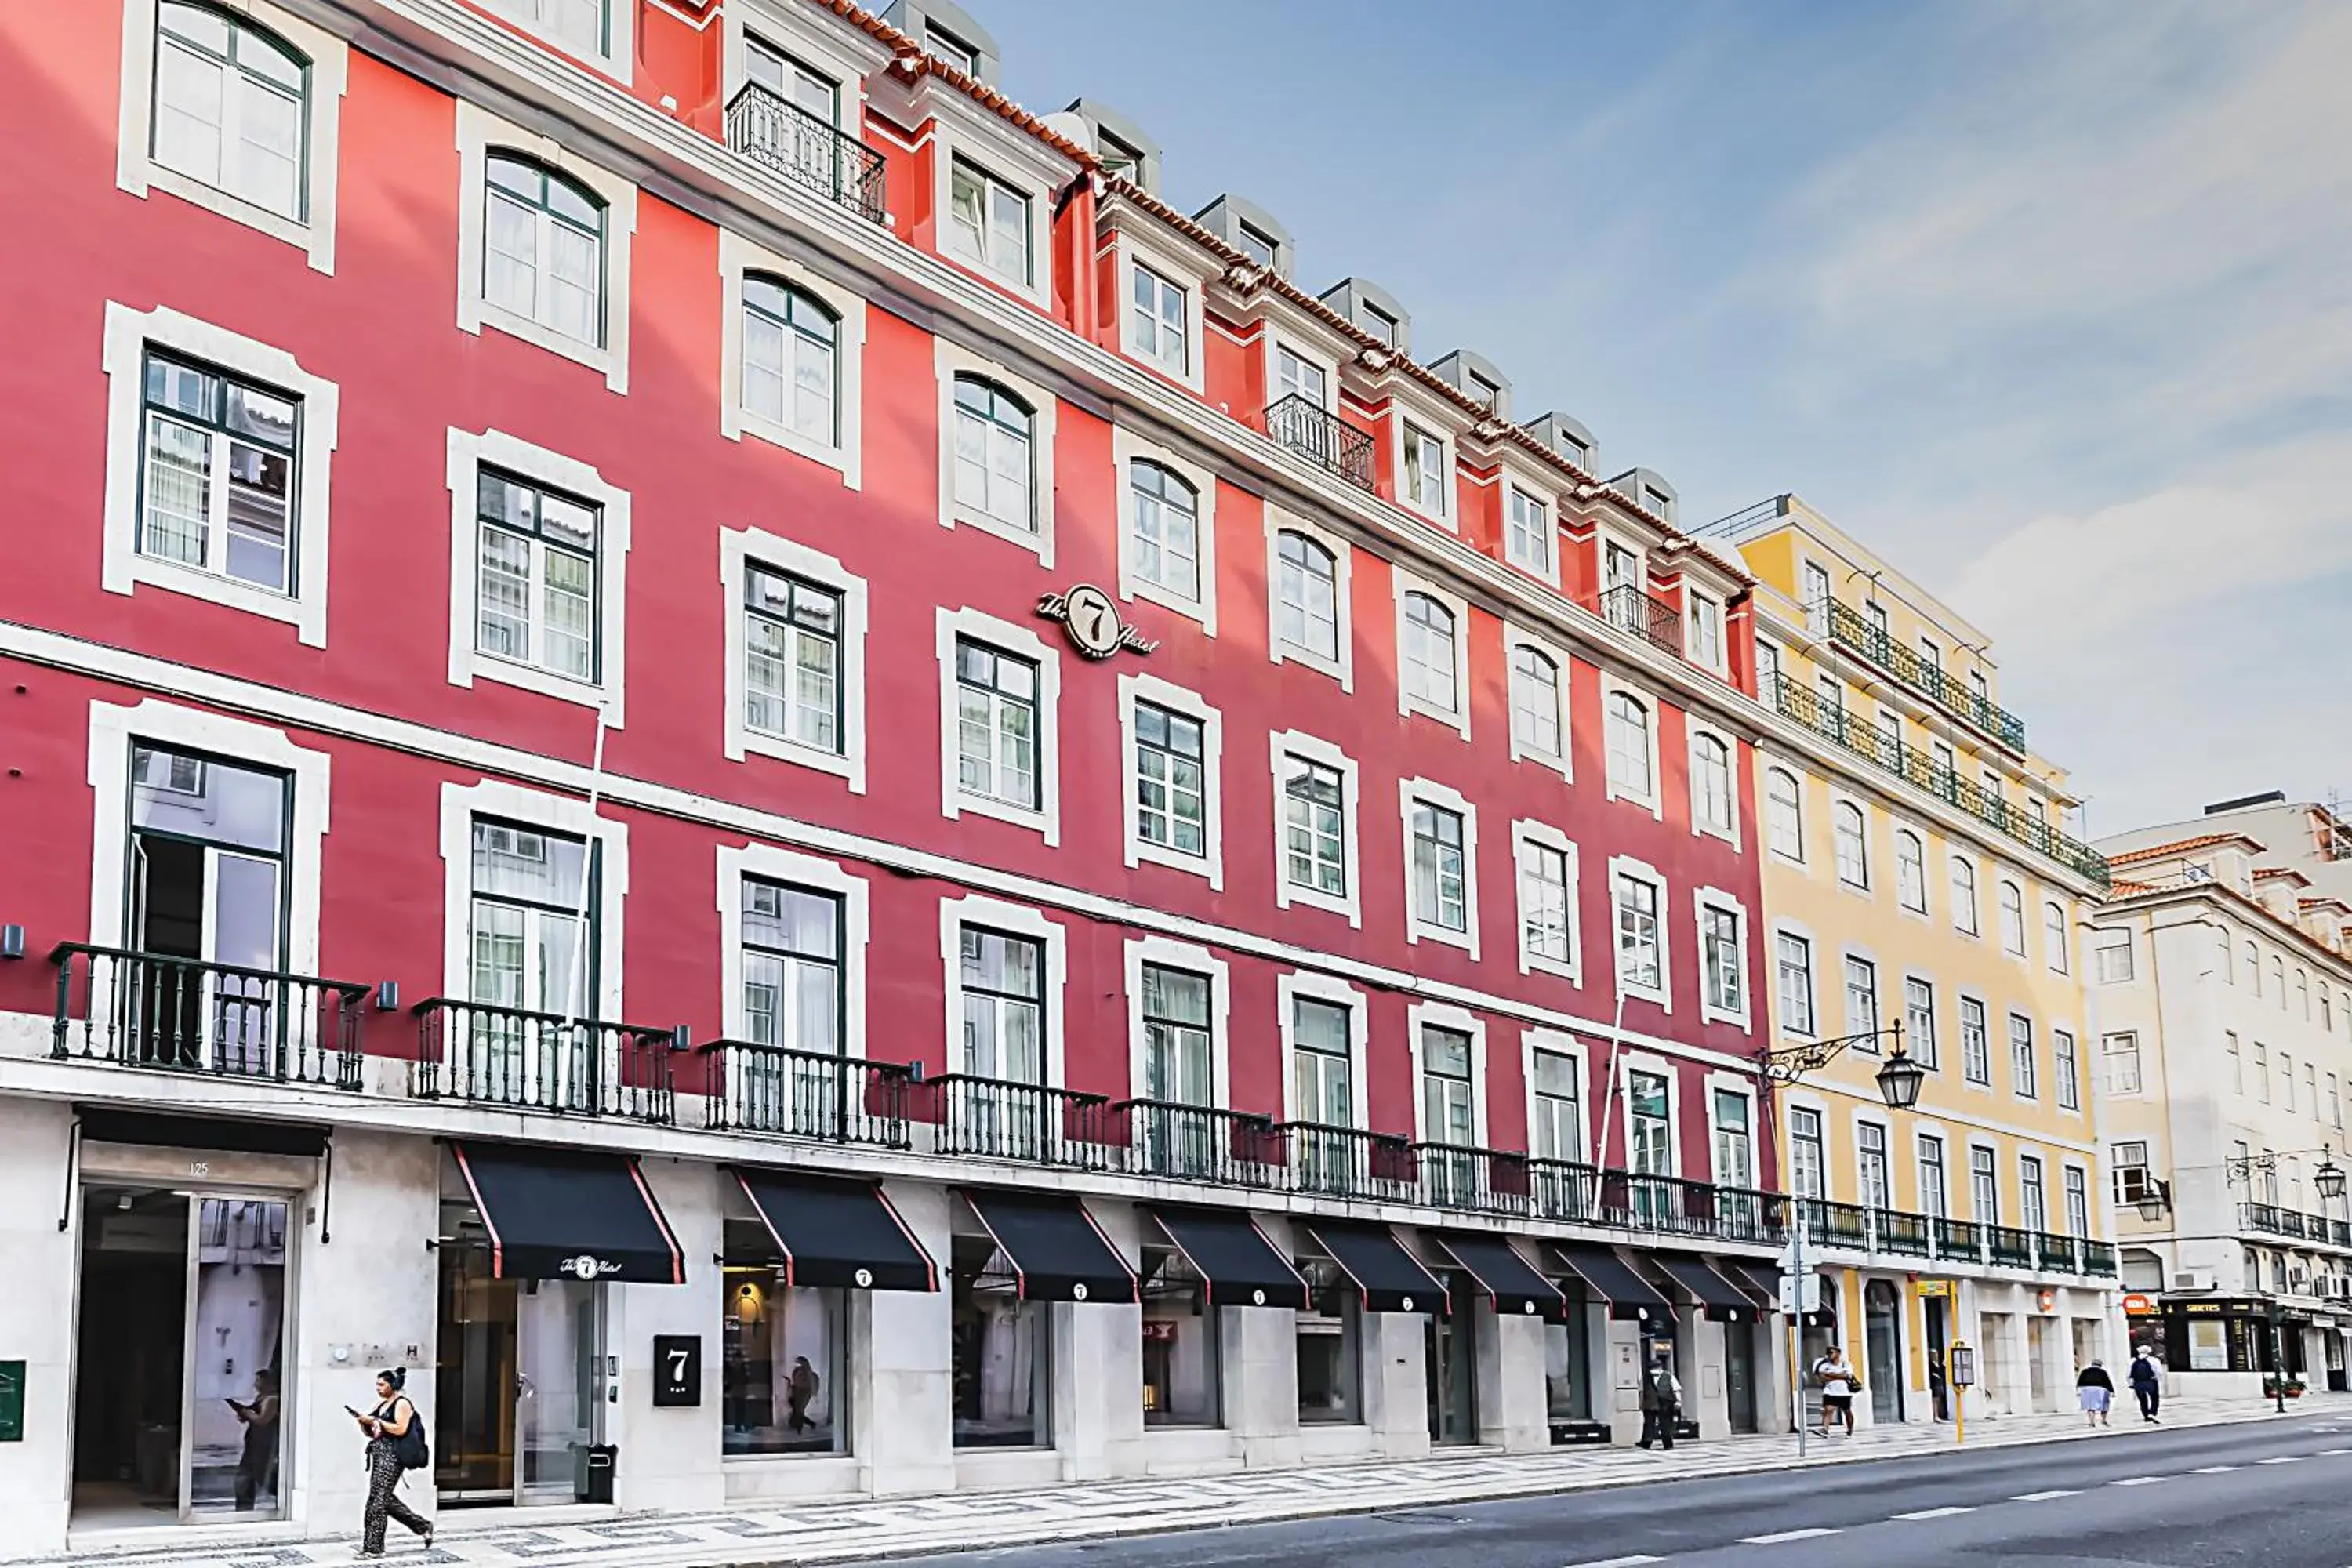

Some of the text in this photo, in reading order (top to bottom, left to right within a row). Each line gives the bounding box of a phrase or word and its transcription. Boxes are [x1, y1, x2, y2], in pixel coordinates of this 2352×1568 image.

[1035, 592, 1160, 653] The 7 Hotel
[189, 1163, 209, 1177] 125
[406, 1345, 418, 1357] H
[667, 1348, 689, 1382] 7
